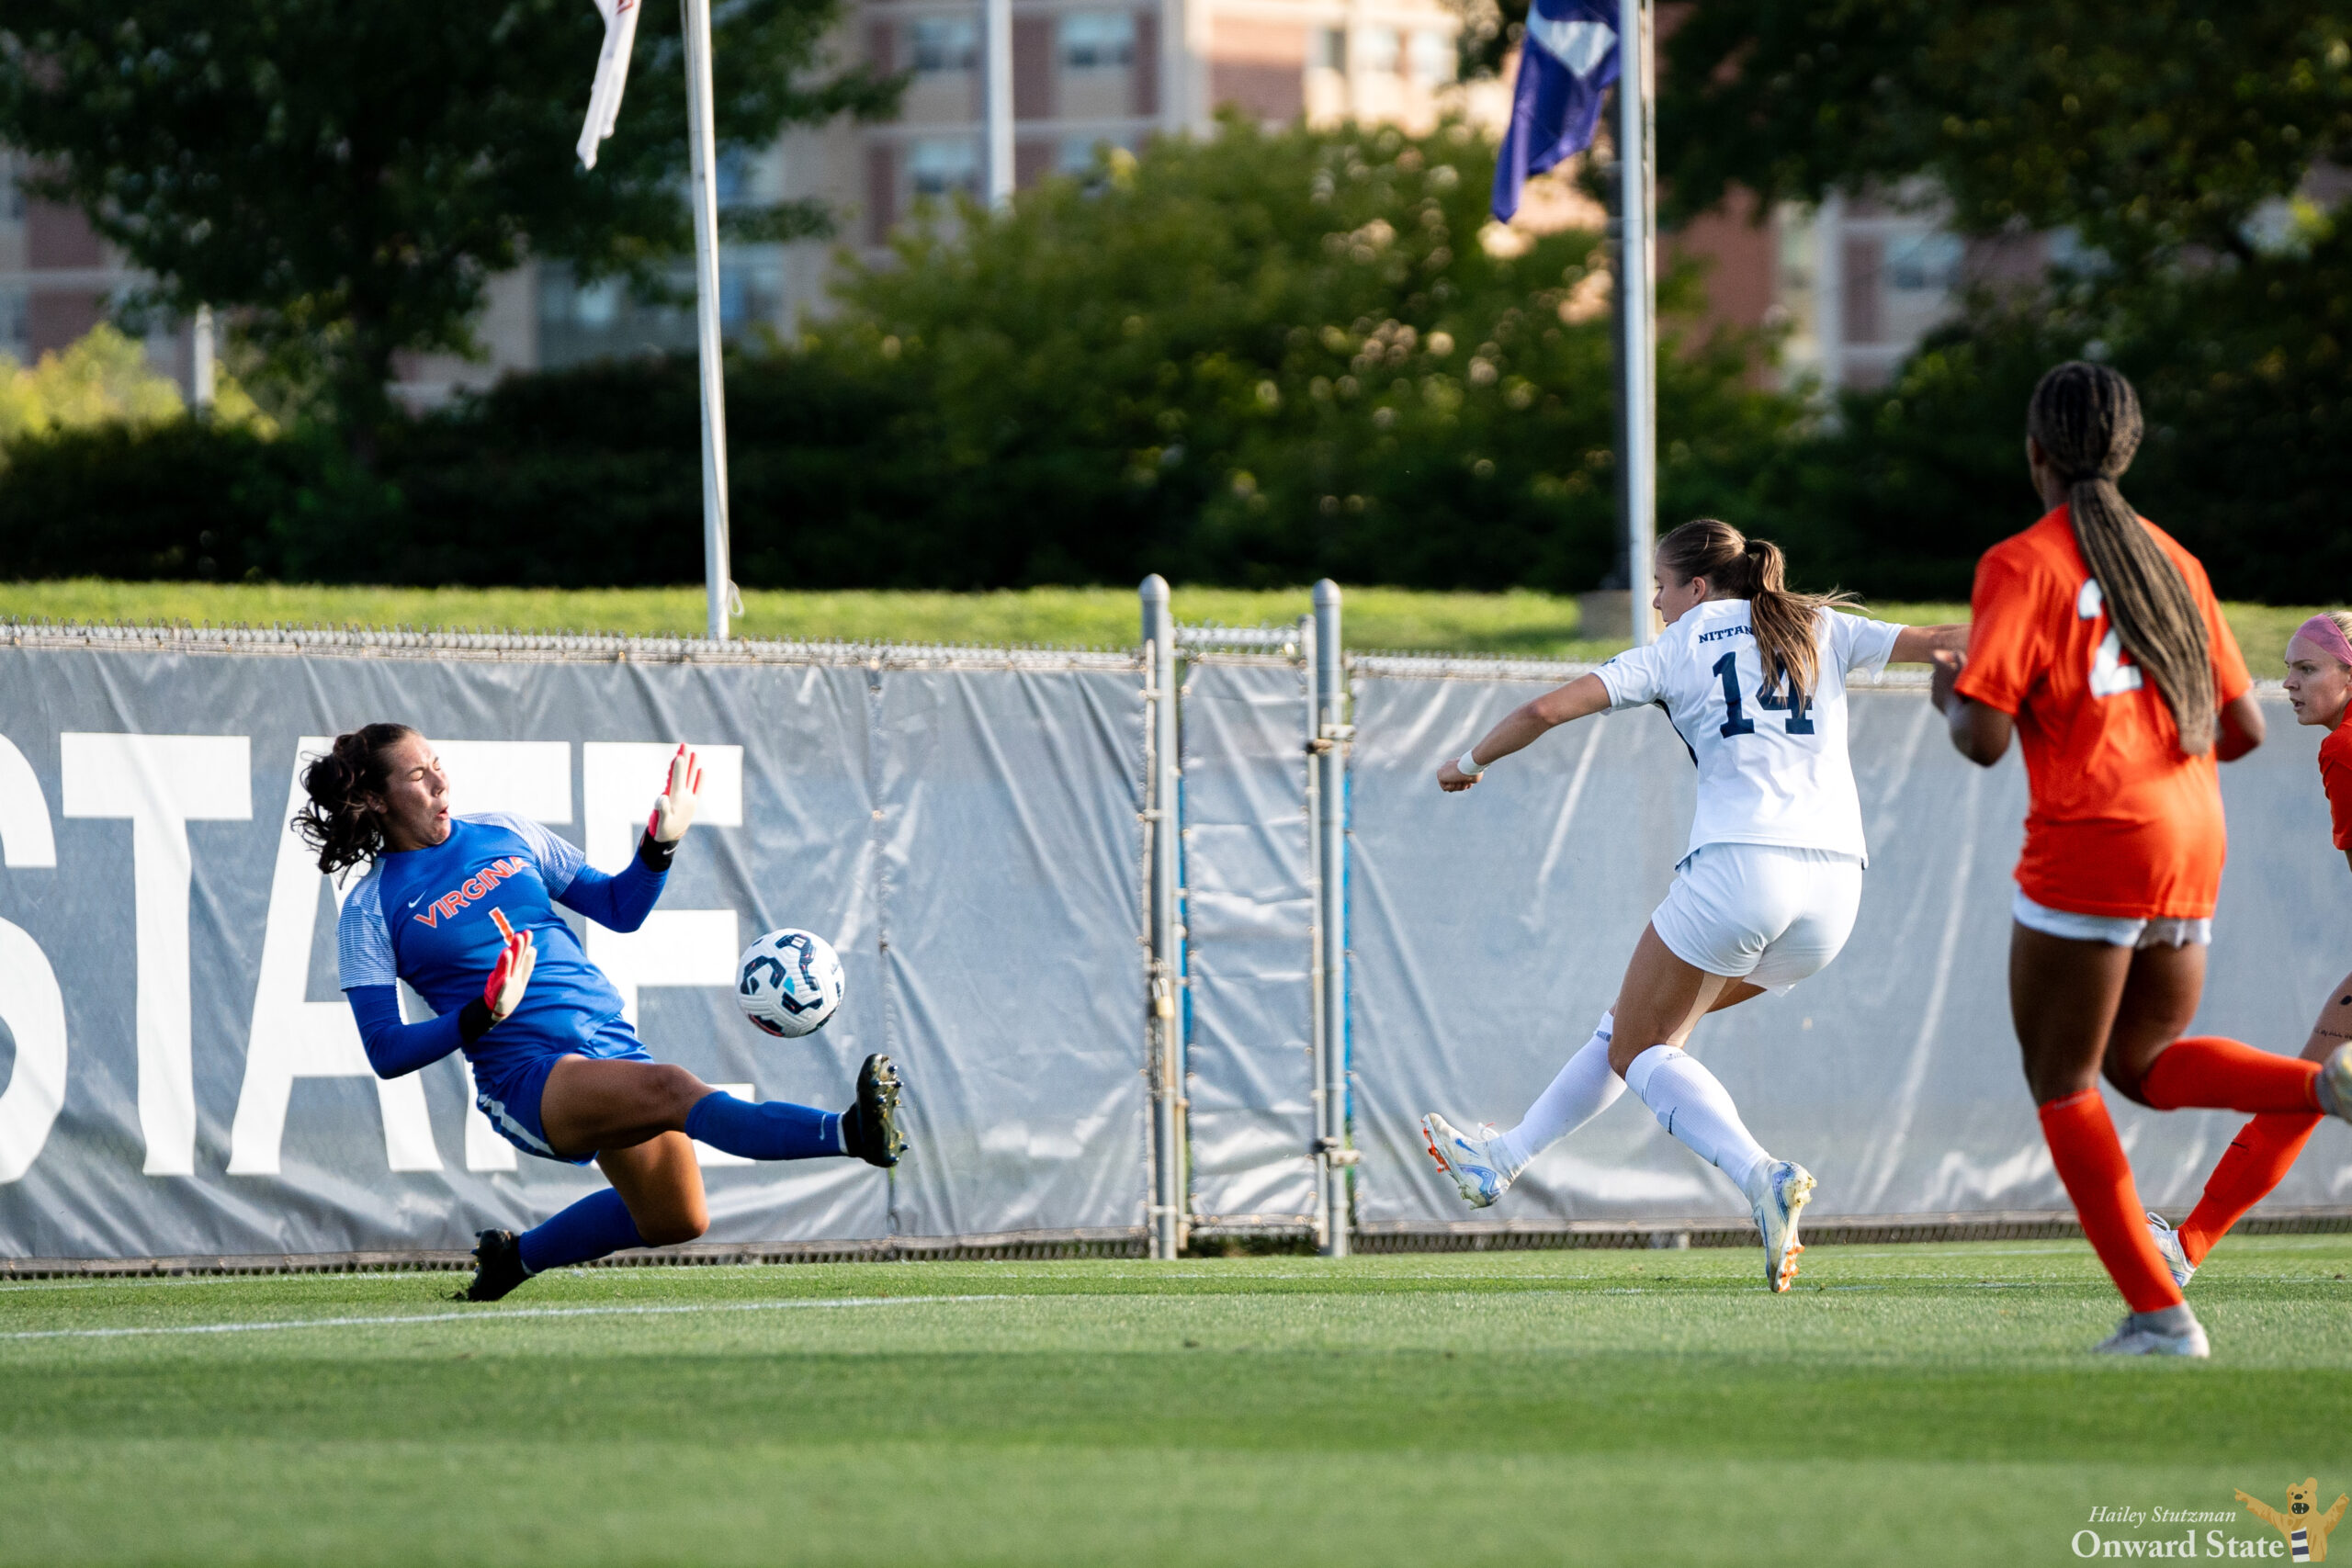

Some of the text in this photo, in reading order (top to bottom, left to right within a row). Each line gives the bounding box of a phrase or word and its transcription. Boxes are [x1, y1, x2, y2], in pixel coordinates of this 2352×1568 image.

[1698, 625, 1756, 644] NITTAN
[2077, 576, 2143, 699] 2
[1712, 650, 1815, 739] 14
[413, 855, 531, 929] VIRGINIA
